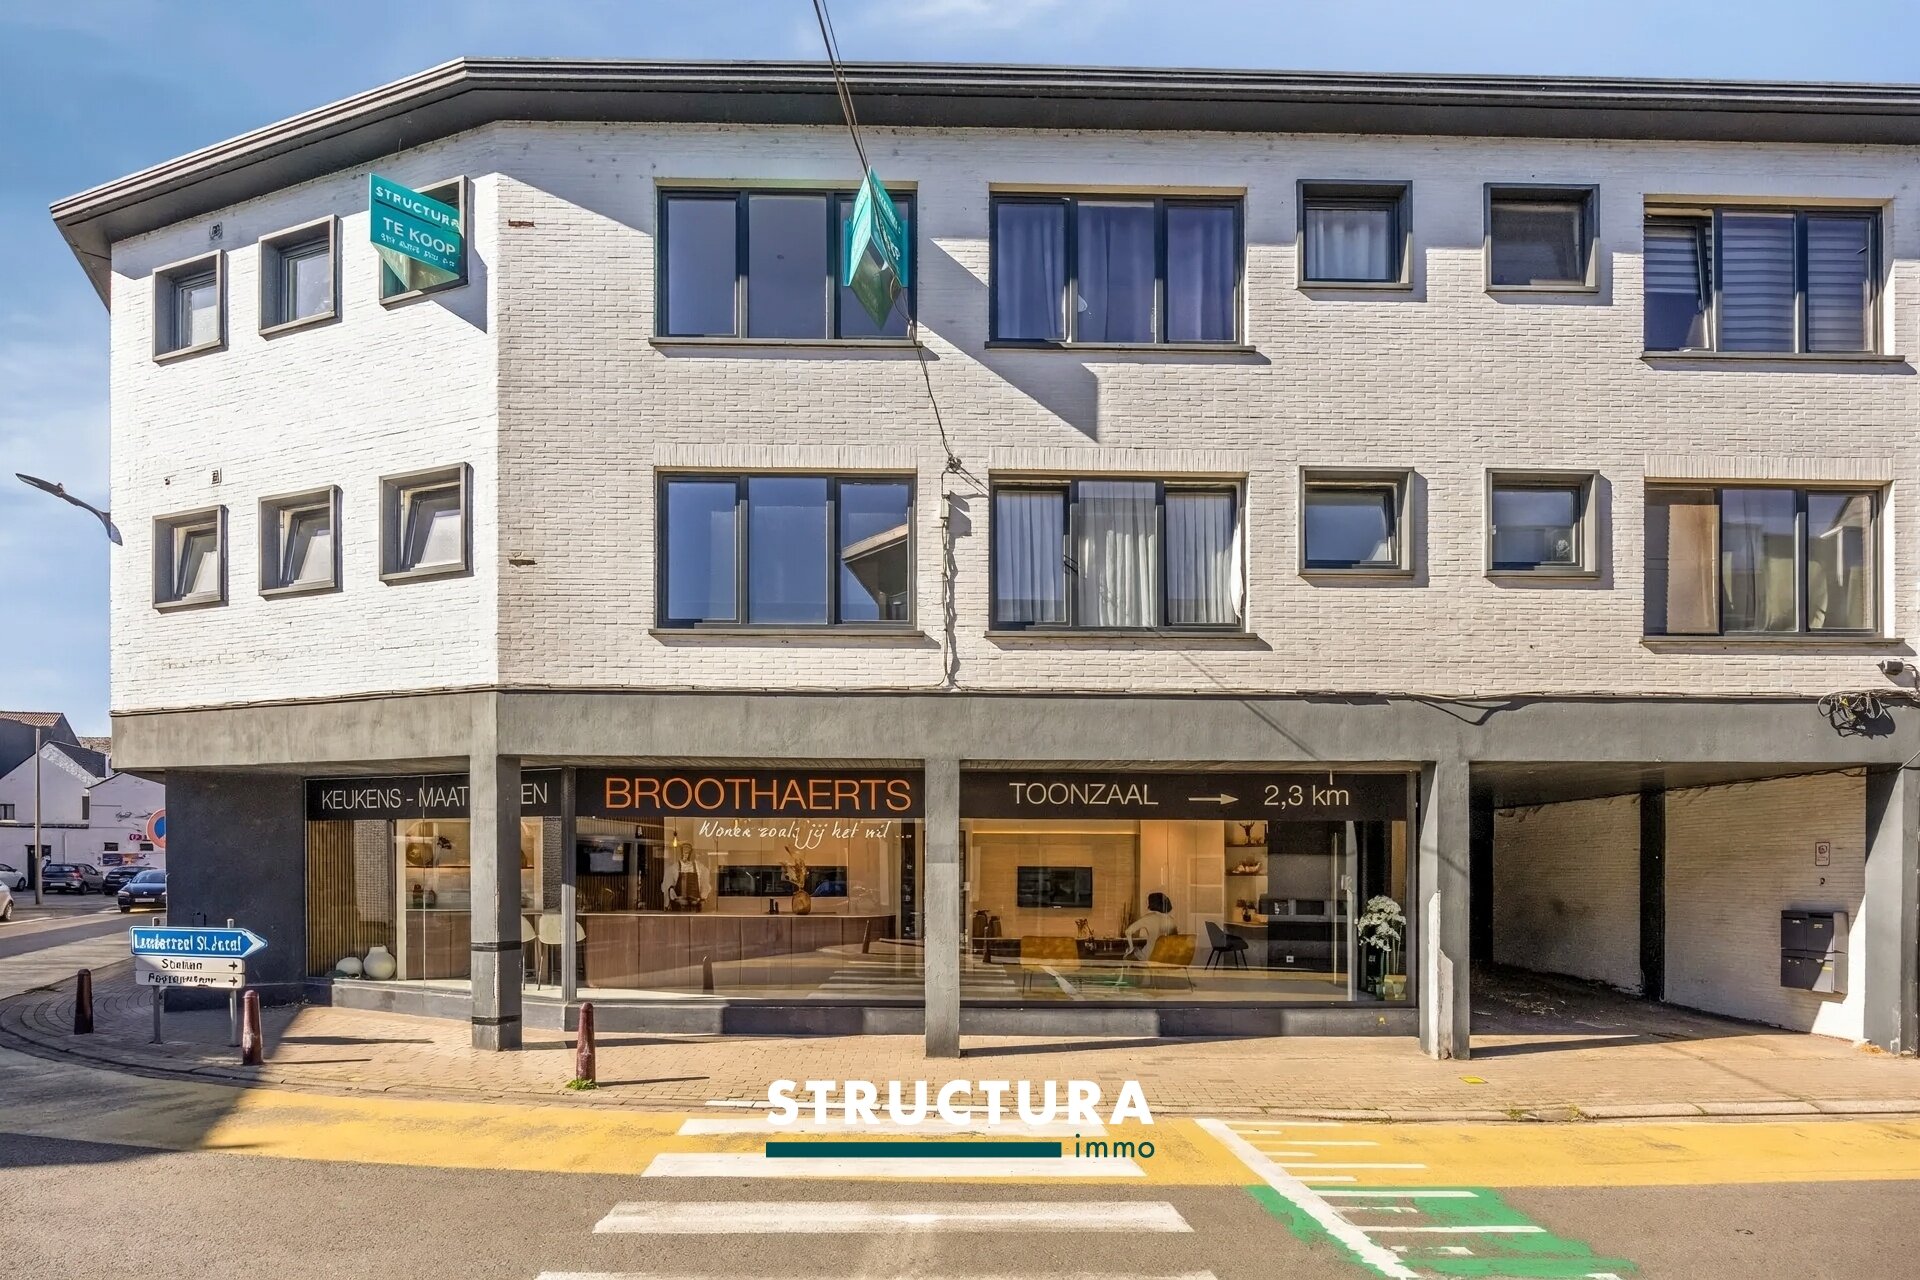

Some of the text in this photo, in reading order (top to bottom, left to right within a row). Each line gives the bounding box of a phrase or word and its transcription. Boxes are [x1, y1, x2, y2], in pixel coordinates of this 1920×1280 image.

[375, 186, 460, 229] STRUCTURA
[383, 216, 404, 237] TE
[409, 227, 456, 256] KOOP
[321, 788, 402, 810] KEUKENS
[605, 777, 912, 811] BROOTHAERTS
[1009, 782, 1349, 811] TOONZAAL 2,3 km
[831, 820, 859, 839] het
